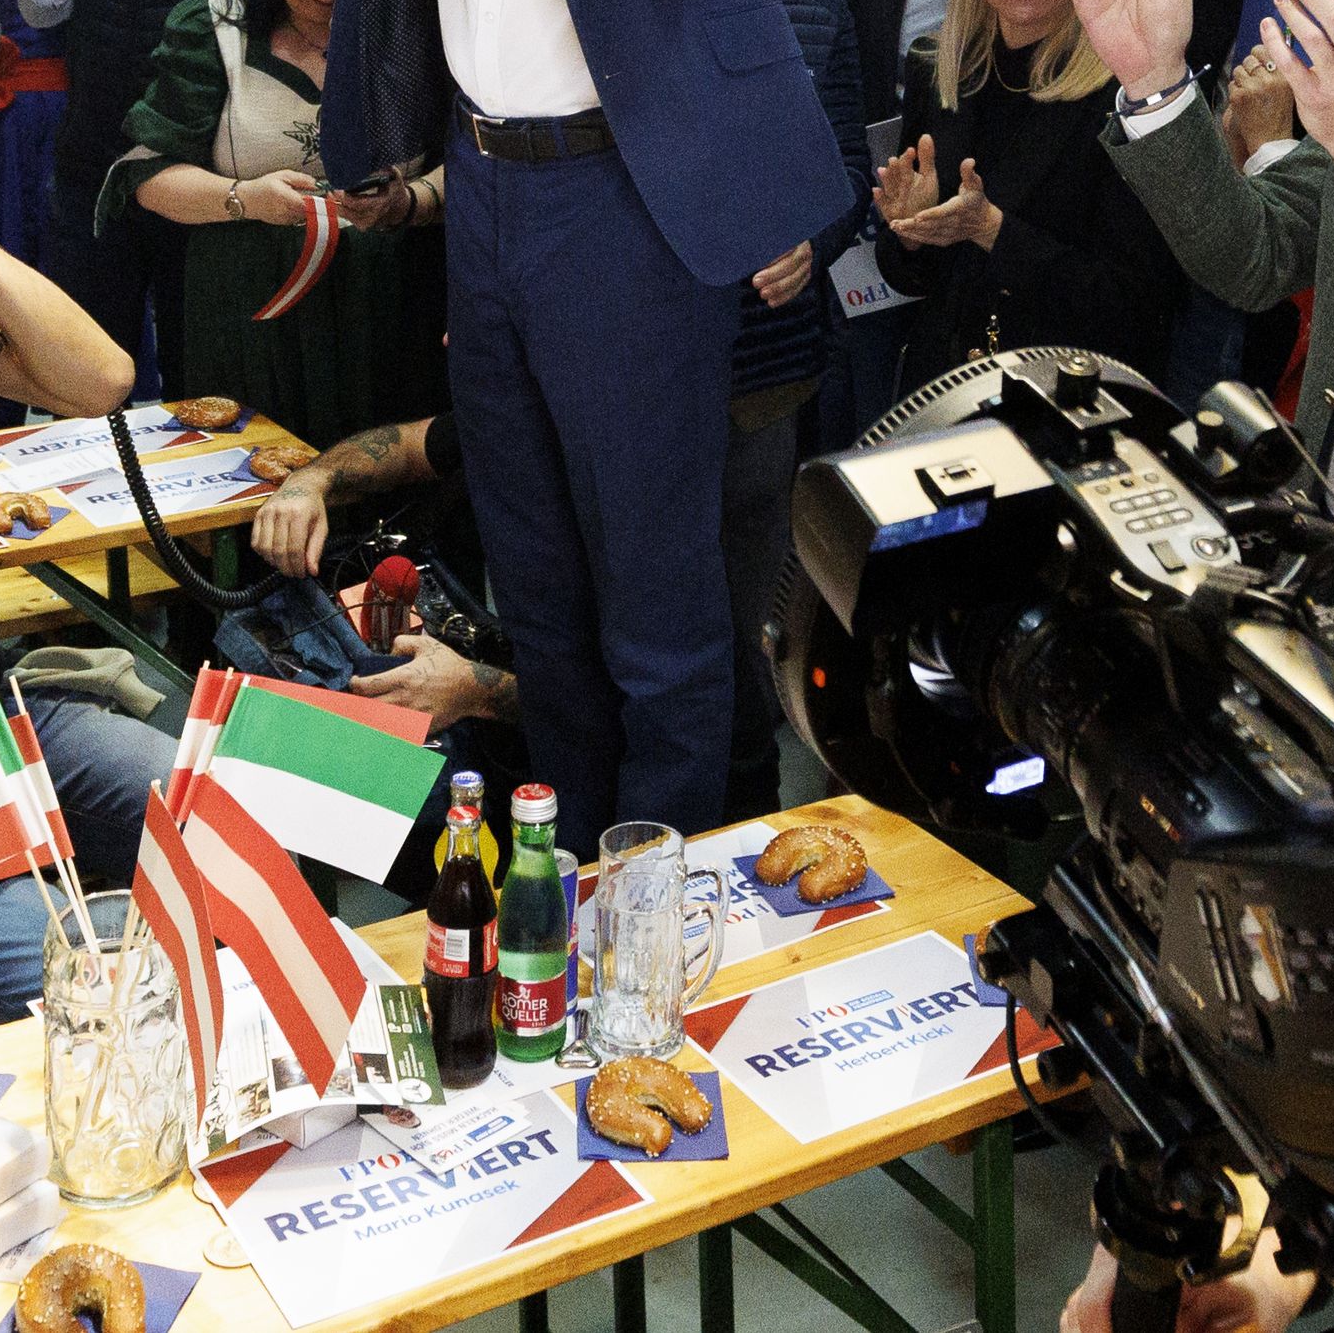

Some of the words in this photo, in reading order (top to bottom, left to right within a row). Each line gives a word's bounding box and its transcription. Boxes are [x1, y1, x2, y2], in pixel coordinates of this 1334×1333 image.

[502, 1008, 547, 1022] QUELLE
[745, 981, 980, 1078] RESERVIERT
[835, 1033, 909, 1073] Herbert
[908, 1023, 954, 1053] Kickl
[264, 1129, 559, 1242] RESERVIERT
[354, 1213, 421, 1241] Mario
[424, 1177, 520, 1218] Kunasek
